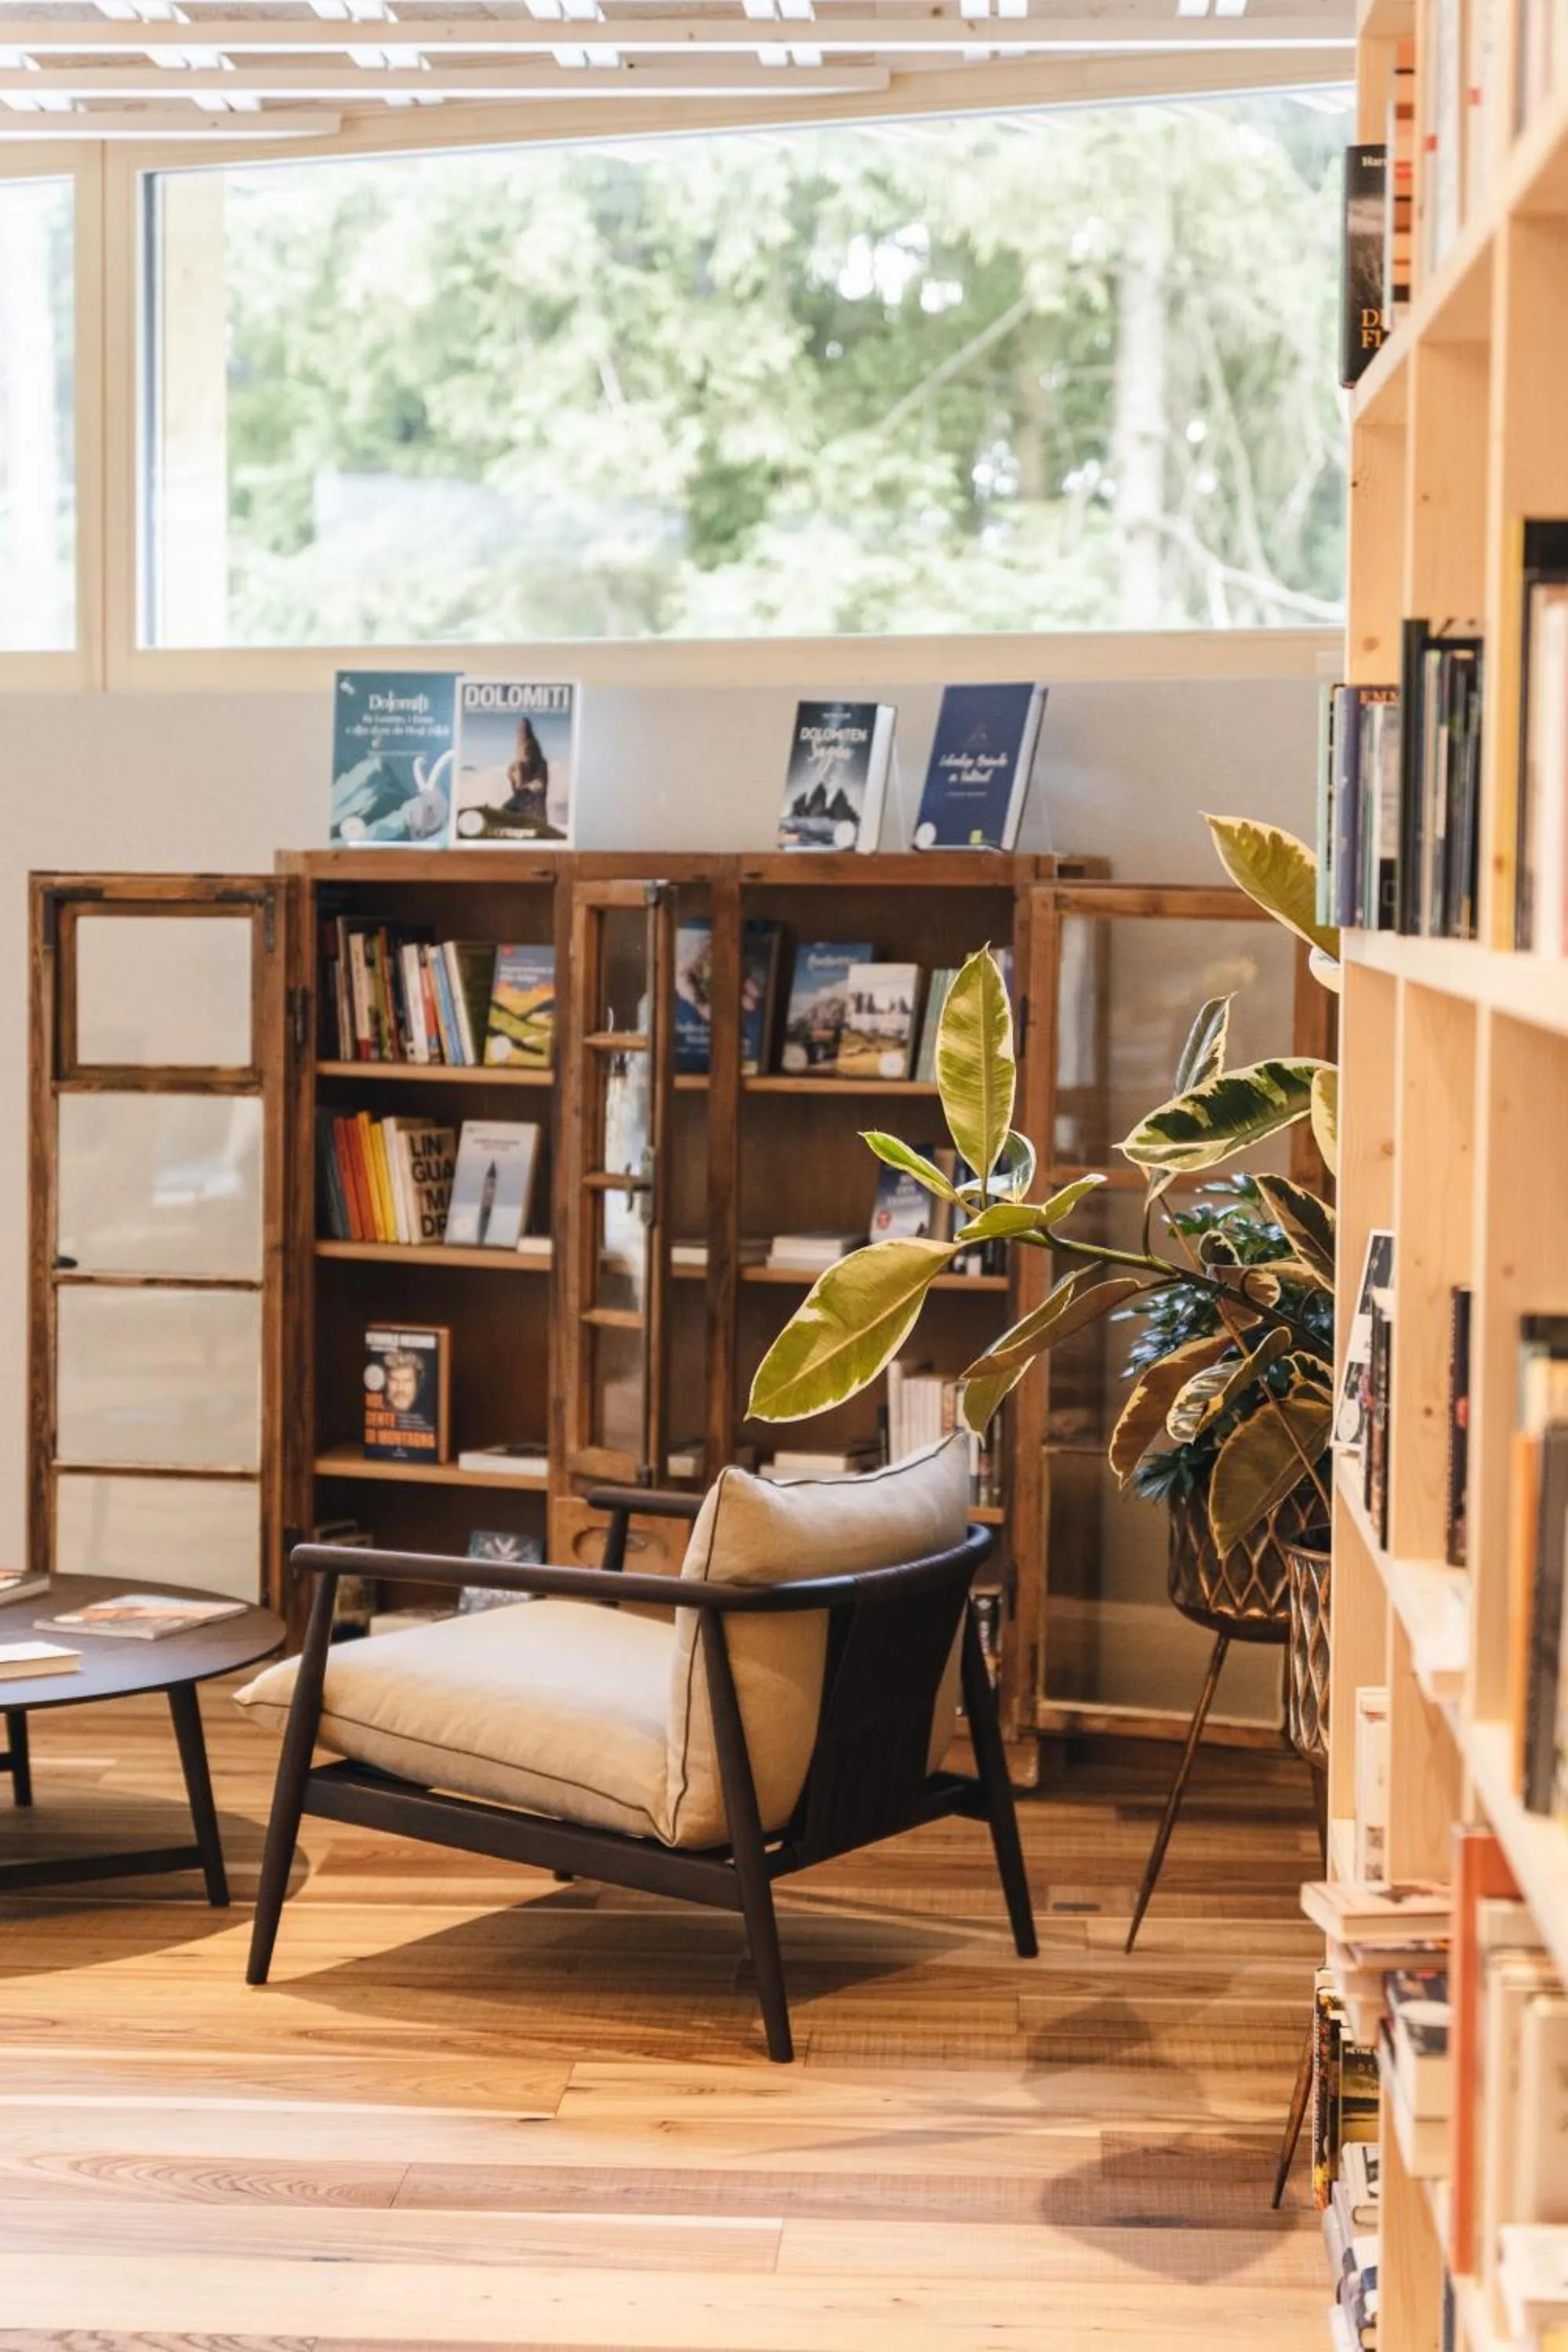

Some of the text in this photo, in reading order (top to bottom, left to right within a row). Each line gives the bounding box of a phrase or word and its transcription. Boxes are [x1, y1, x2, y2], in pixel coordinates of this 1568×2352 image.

[368, 691, 430, 714] Dolomiti
[465, 684, 569, 707] DOLOMITI
[800, 727, 867, 742] DOLOMITEN
[409, 1135, 442, 1157] LIN
[412, 1159, 455, 1183] GUA
